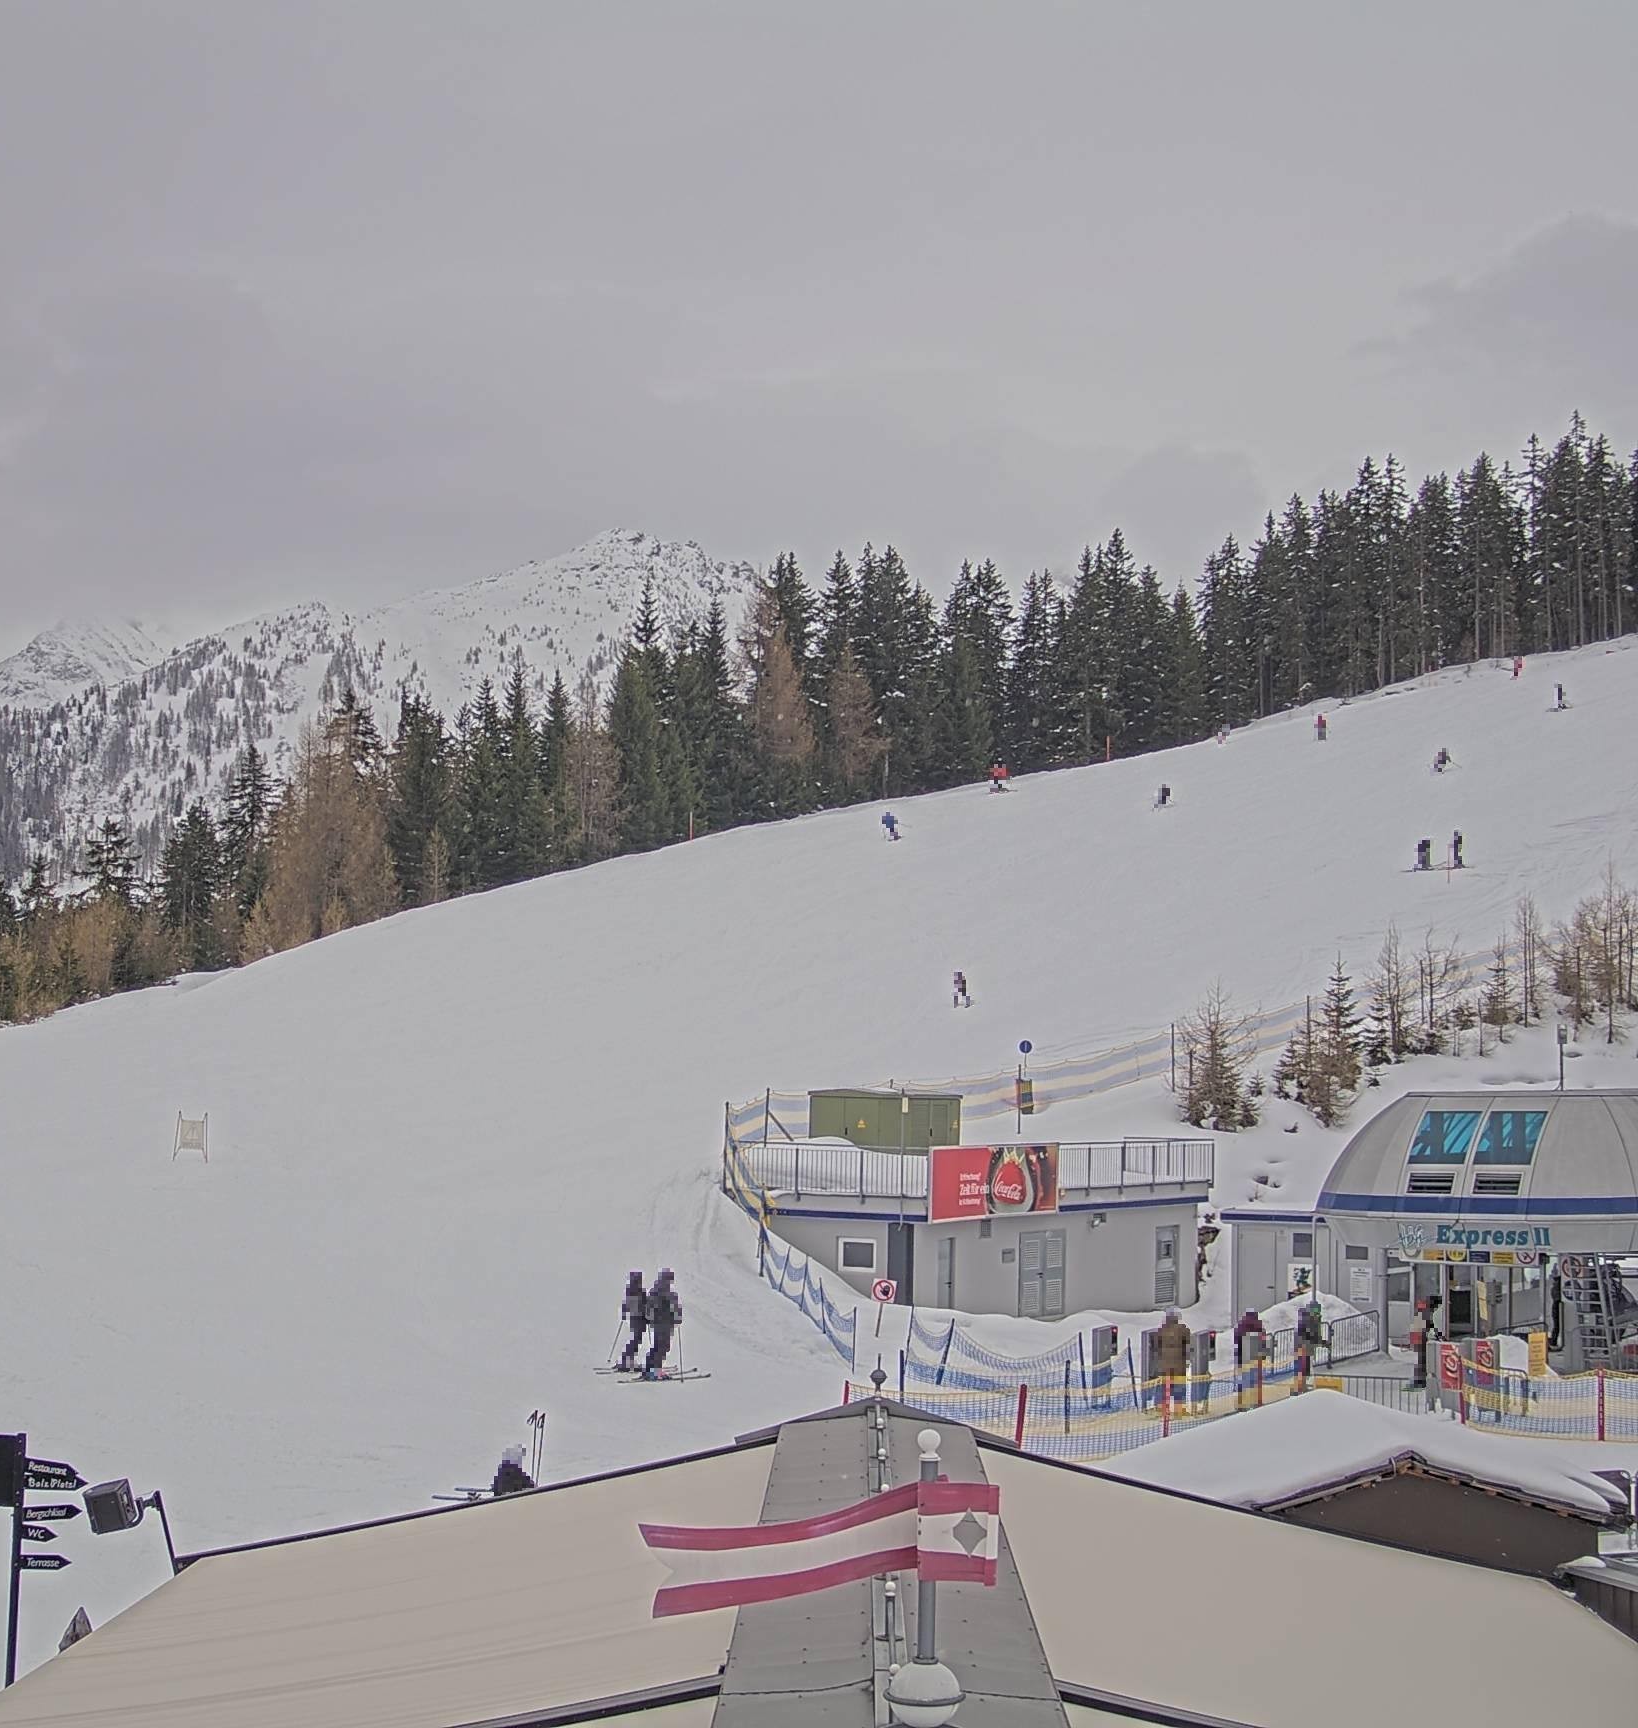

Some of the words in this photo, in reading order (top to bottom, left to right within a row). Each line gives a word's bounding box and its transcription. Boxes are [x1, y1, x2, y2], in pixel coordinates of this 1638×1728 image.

[1436, 1224, 1529, 1249] Express
[28, 1461, 67, 1476] Restaurant
[27, 1527, 46, 1539] WC
[26, 1557, 60, 1568] Terrasse
